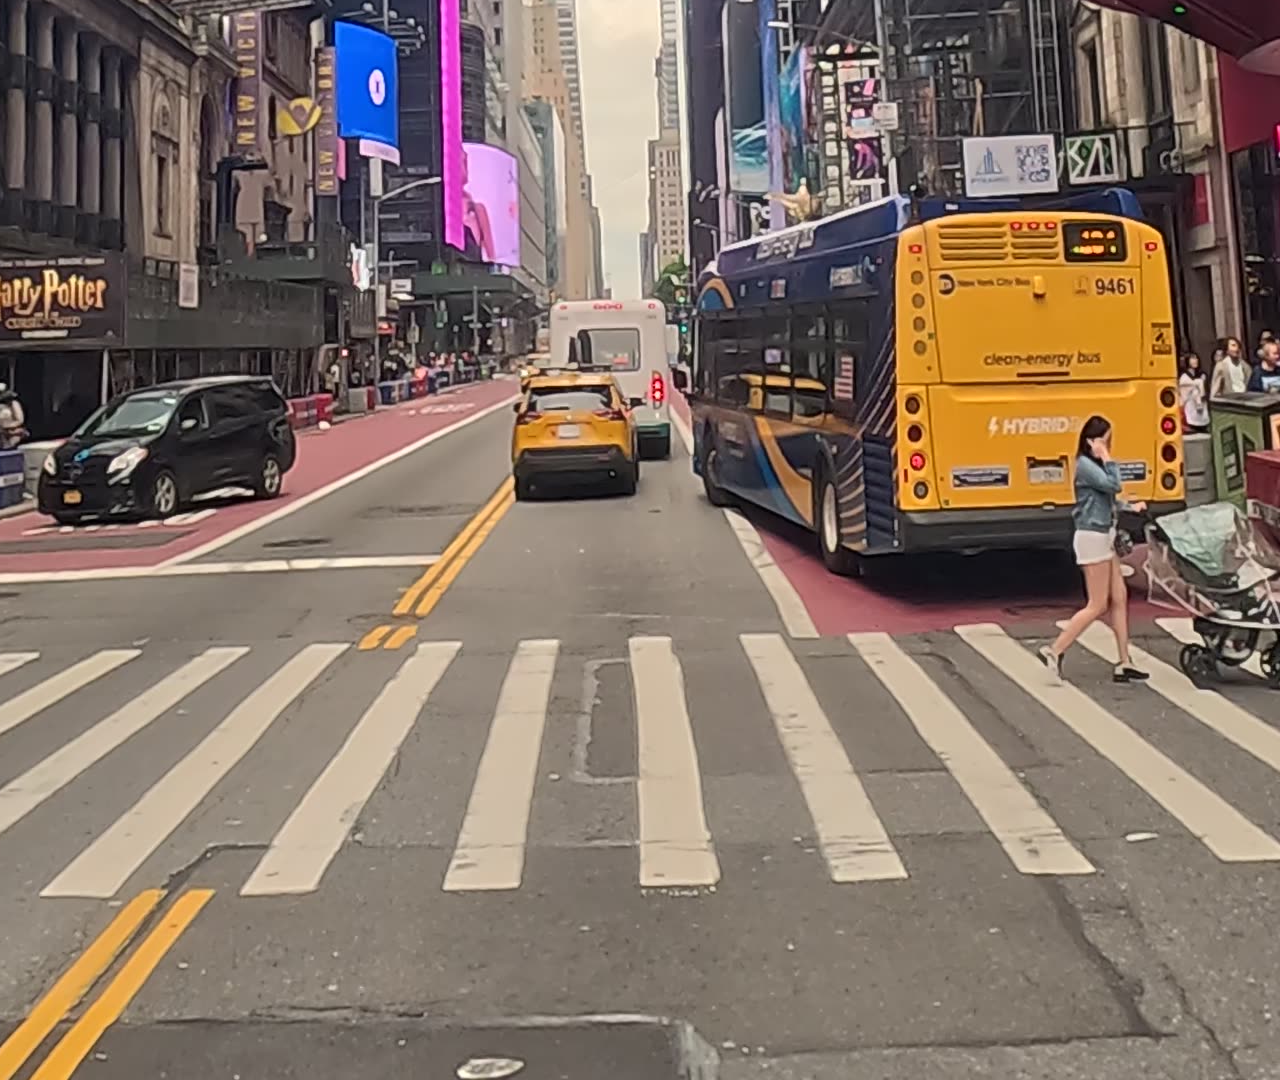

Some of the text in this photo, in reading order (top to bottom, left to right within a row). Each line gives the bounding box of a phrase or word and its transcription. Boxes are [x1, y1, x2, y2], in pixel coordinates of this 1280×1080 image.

[236, 95, 256, 146] NEW
[318, 150, 333, 192] NEW
[43, 269, 108, 319] Potter
[1095, 278, 1136, 295] 9461
[983, 351, 1102, 367] clean-energy bus
[1002, 416, 1069, 435] HYBRID
